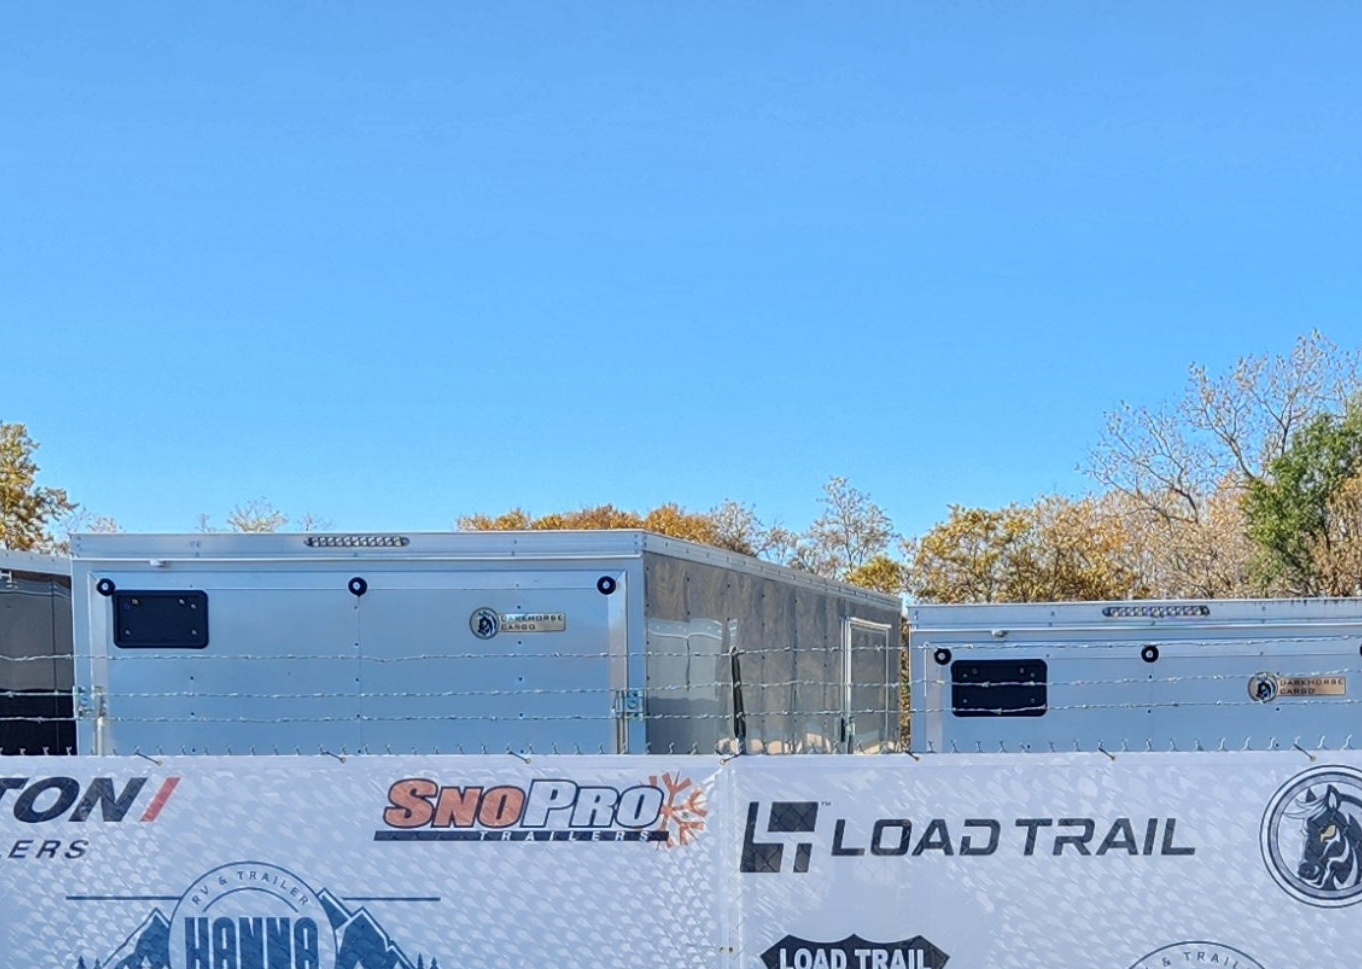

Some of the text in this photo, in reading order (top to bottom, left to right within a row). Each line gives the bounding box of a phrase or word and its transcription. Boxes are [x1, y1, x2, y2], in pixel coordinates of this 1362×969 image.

[479, 830, 650, 842] TRAILERS
[831, 818, 1001, 857] LOAD
[1015, 817, 1196, 857] TRAIL
[191, 870, 310, 906] RV & TRAILER
[1161, 956, 1172, 967] &
